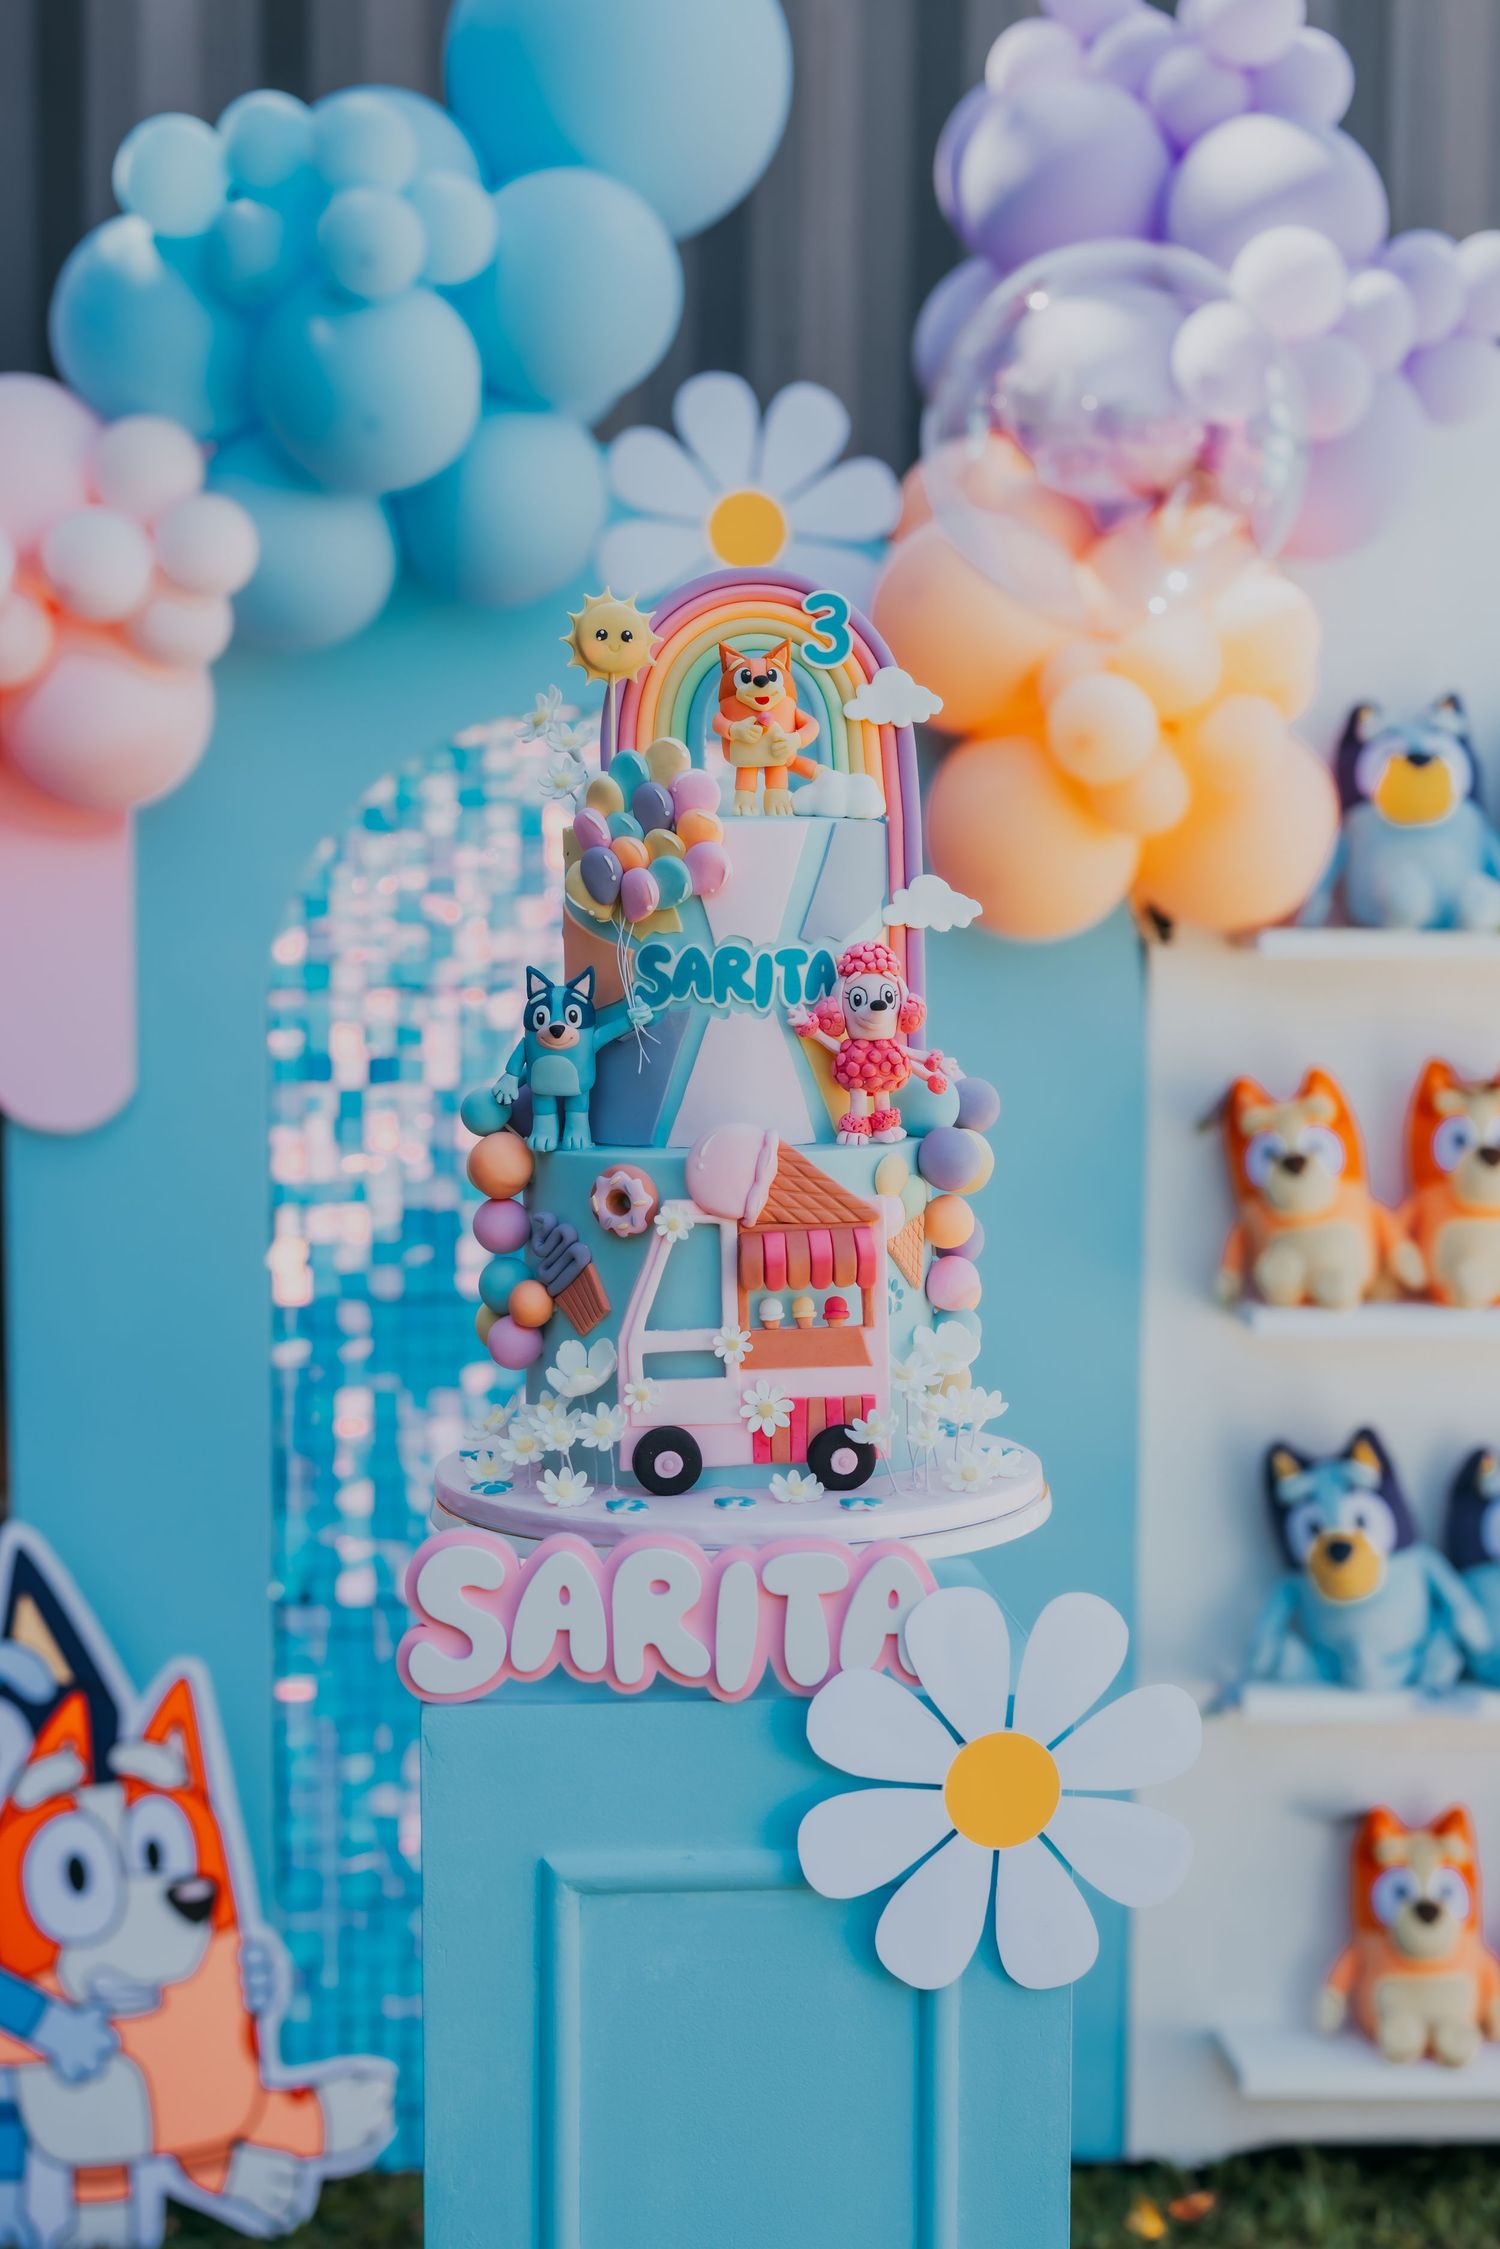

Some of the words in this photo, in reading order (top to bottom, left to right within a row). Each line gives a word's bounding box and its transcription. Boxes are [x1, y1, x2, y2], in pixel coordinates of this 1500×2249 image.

[804, 592, 850, 666] 3
[634, 943, 837, 1009] SARITA
[406, 1543, 928, 1695] SARITA
